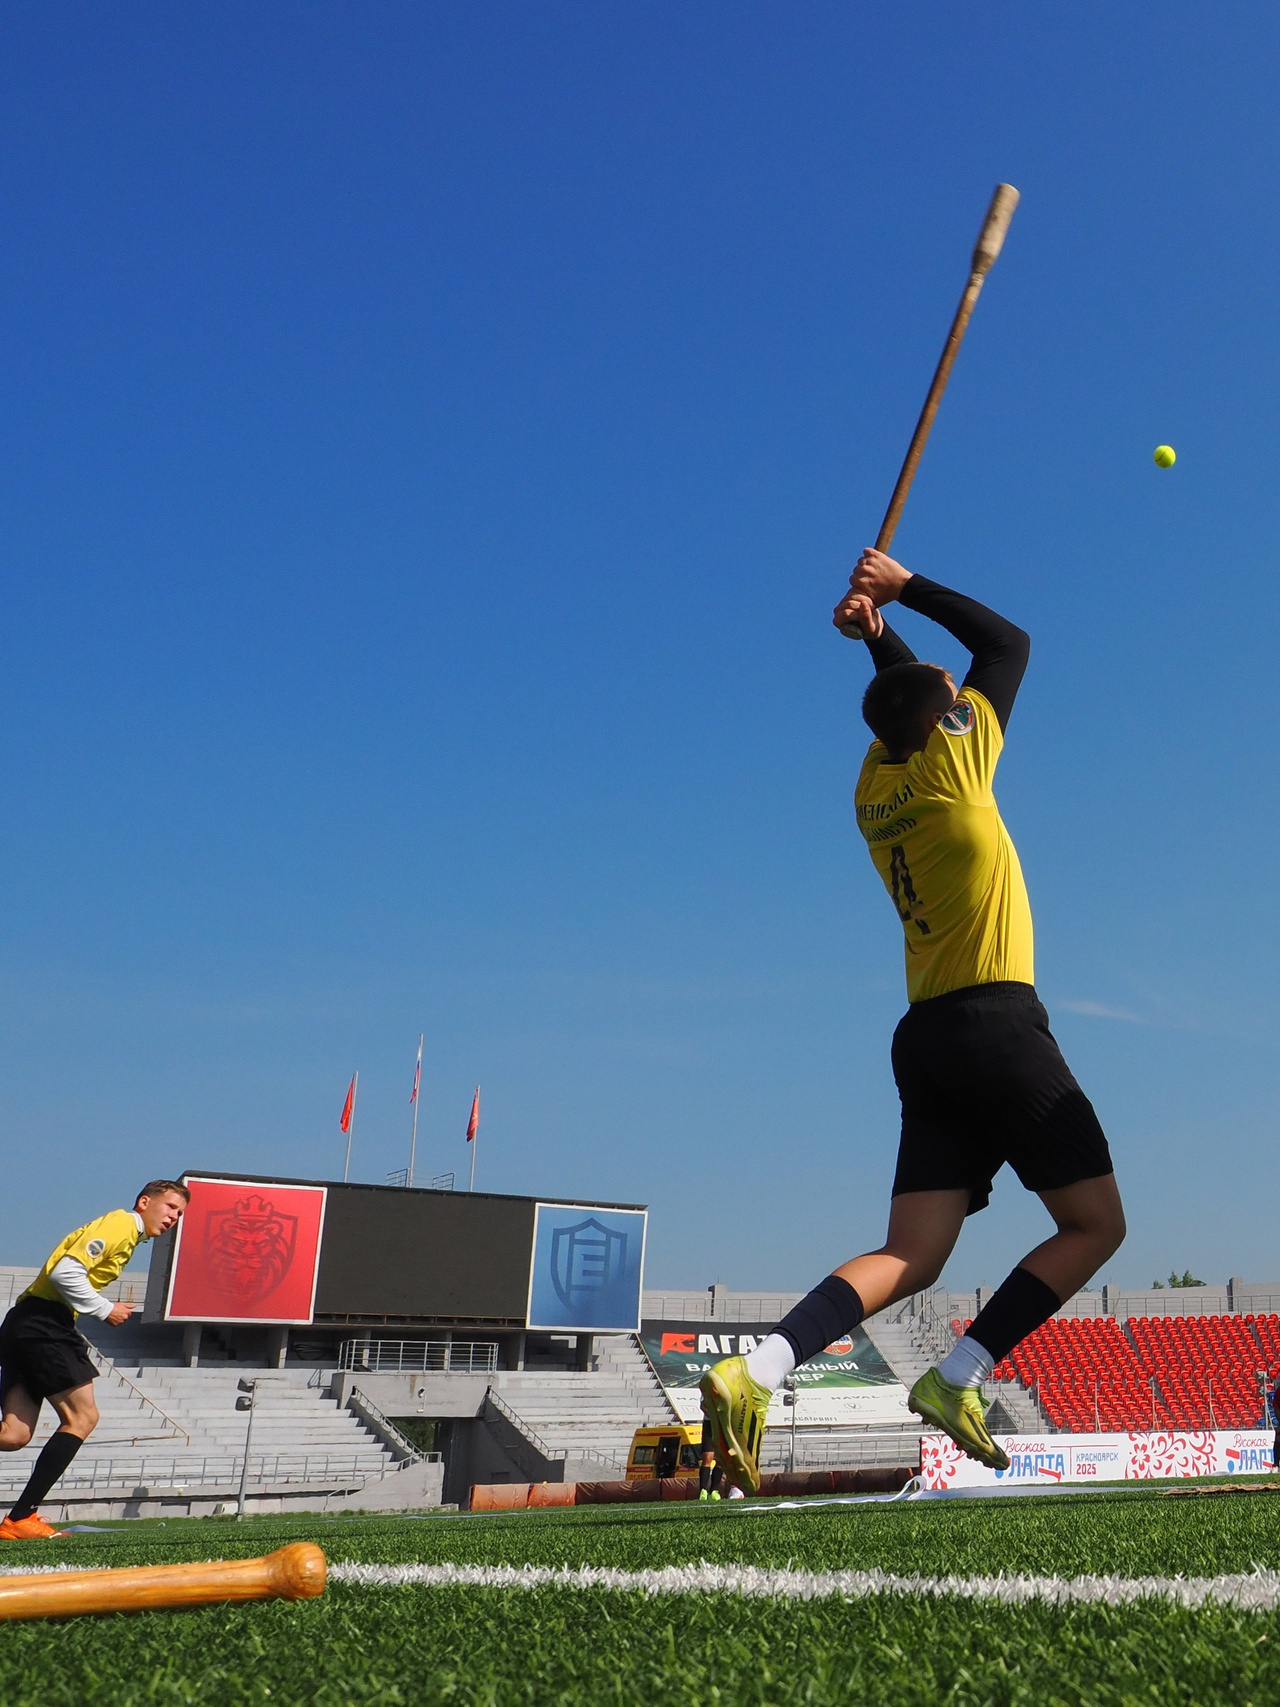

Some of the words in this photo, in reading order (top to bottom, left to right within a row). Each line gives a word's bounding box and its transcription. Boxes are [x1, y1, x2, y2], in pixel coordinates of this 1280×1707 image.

[792, 1360, 859, 1372] ЖНЫЙ
[1004, 1437, 1048, 1453] Русская
[1233, 1433, 1269, 1448] Русская
[1075, 1452, 1119, 1462] КРАСНОЯРСК
[1008, 1453, 1066, 1478] ЛАПТА
[1076, 1463, 1097, 1475] 2025
